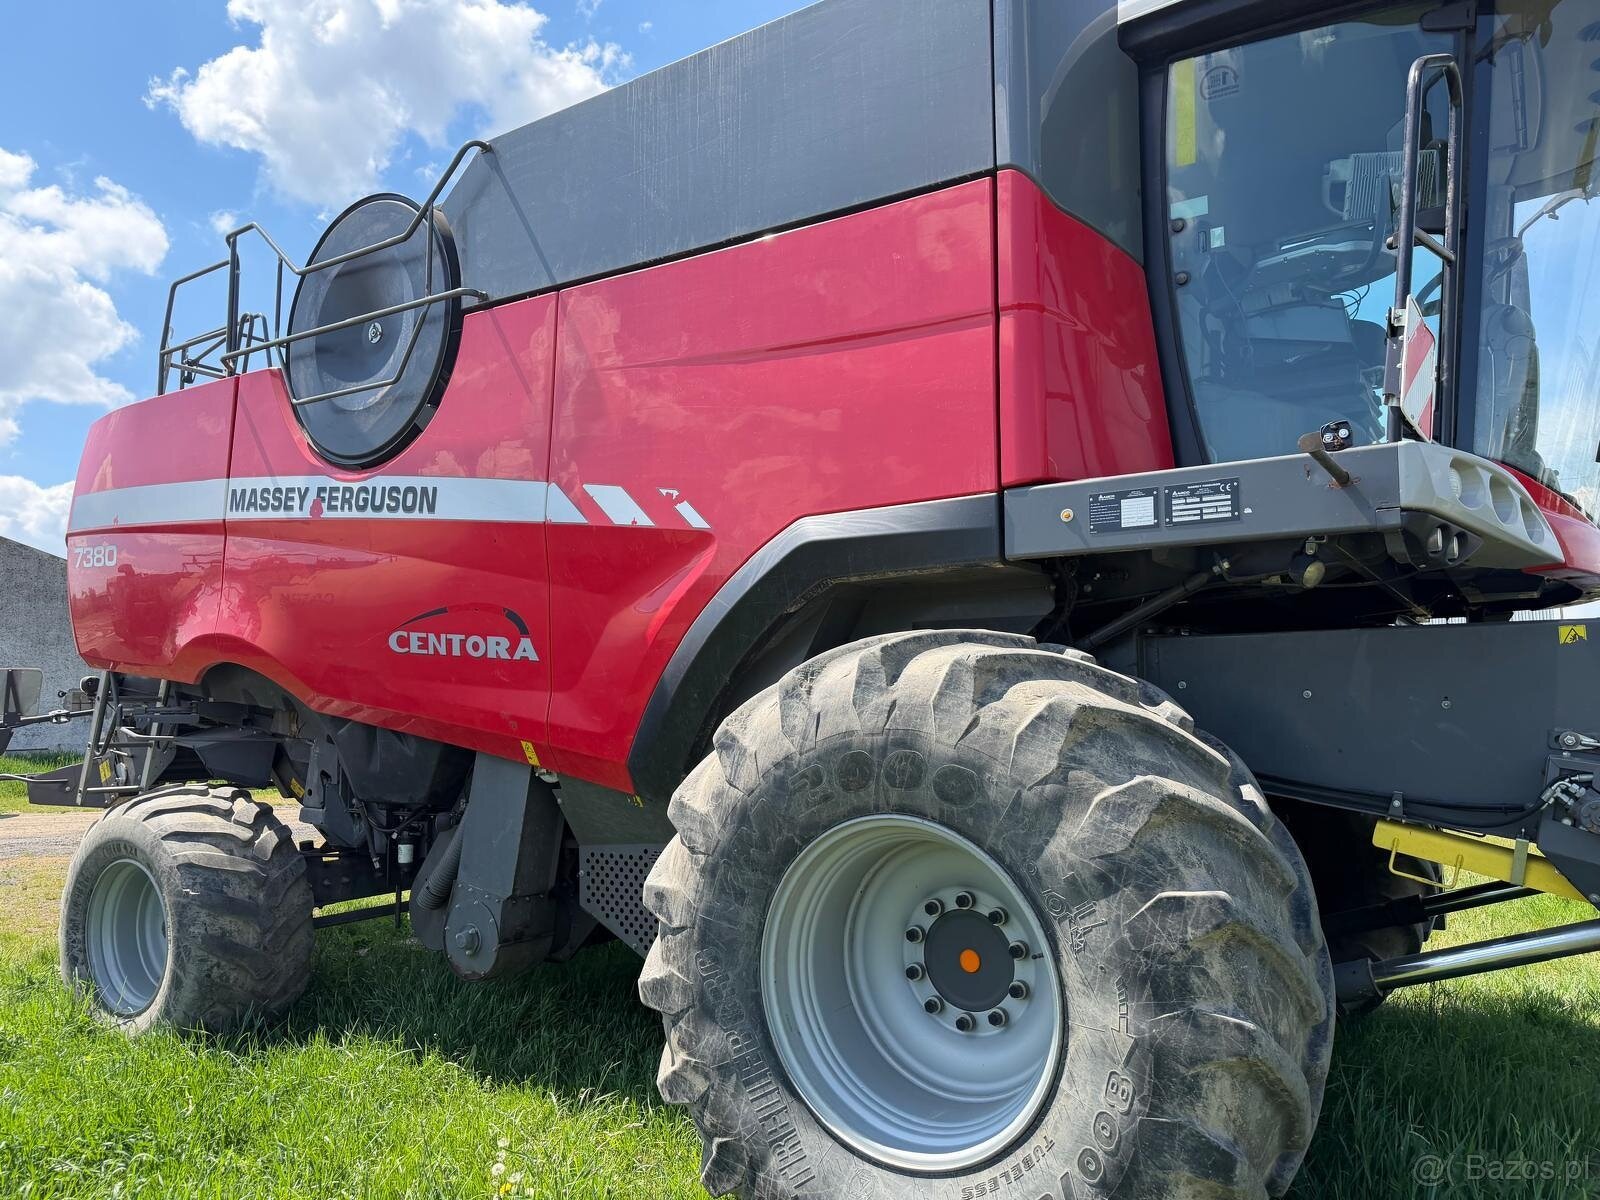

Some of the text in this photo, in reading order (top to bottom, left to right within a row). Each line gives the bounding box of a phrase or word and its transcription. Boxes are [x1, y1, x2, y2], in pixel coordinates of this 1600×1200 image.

[229, 485, 438, 515] MASSEY FERGUSON
[74, 544, 118, 569] 7380
[388, 630, 540, 662] CENTORA
[961, 1135, 1056, 1200] TUBELESS
